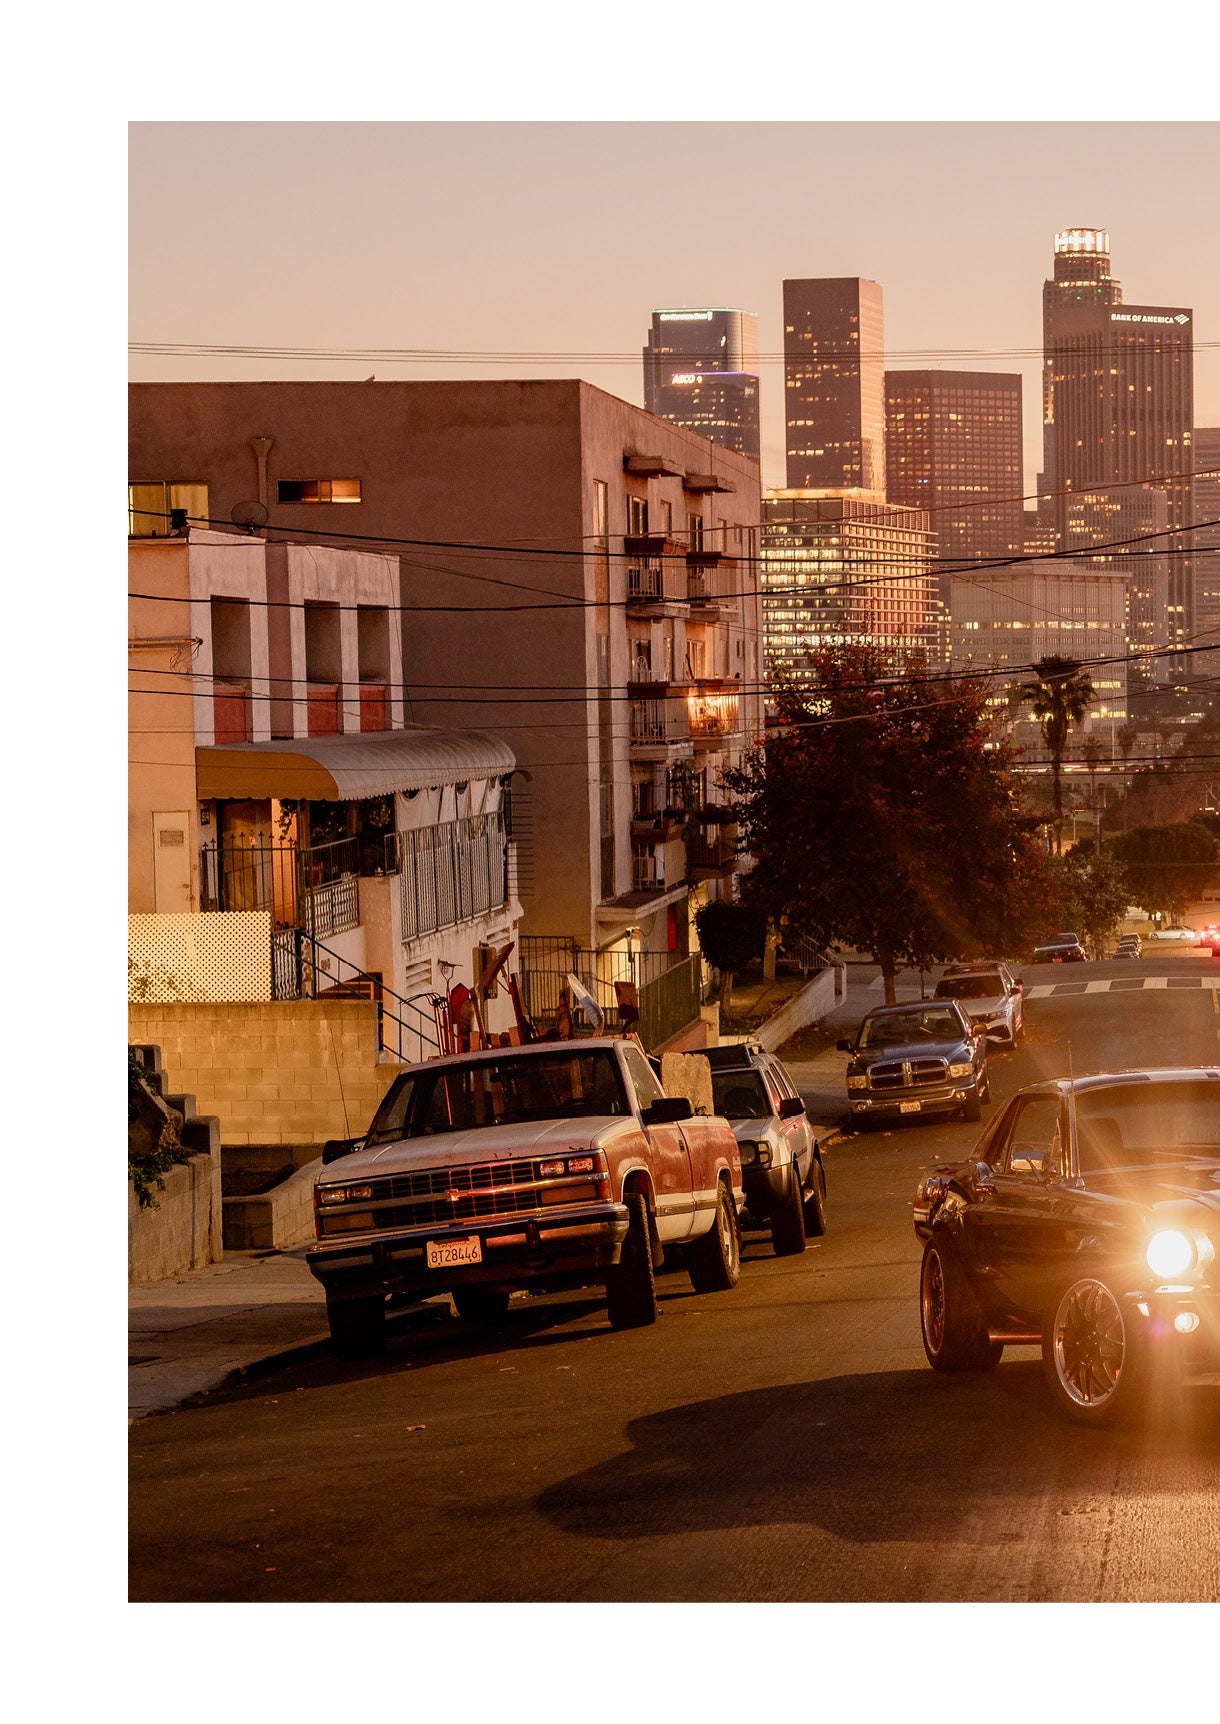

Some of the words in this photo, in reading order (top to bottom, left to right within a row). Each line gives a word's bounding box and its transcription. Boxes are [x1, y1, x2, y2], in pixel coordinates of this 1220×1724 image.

[1110, 313, 1131, 322] BANK
[1142, 315, 1174, 324] AMERICA
[431, 1246, 478, 1263] 8T28446
